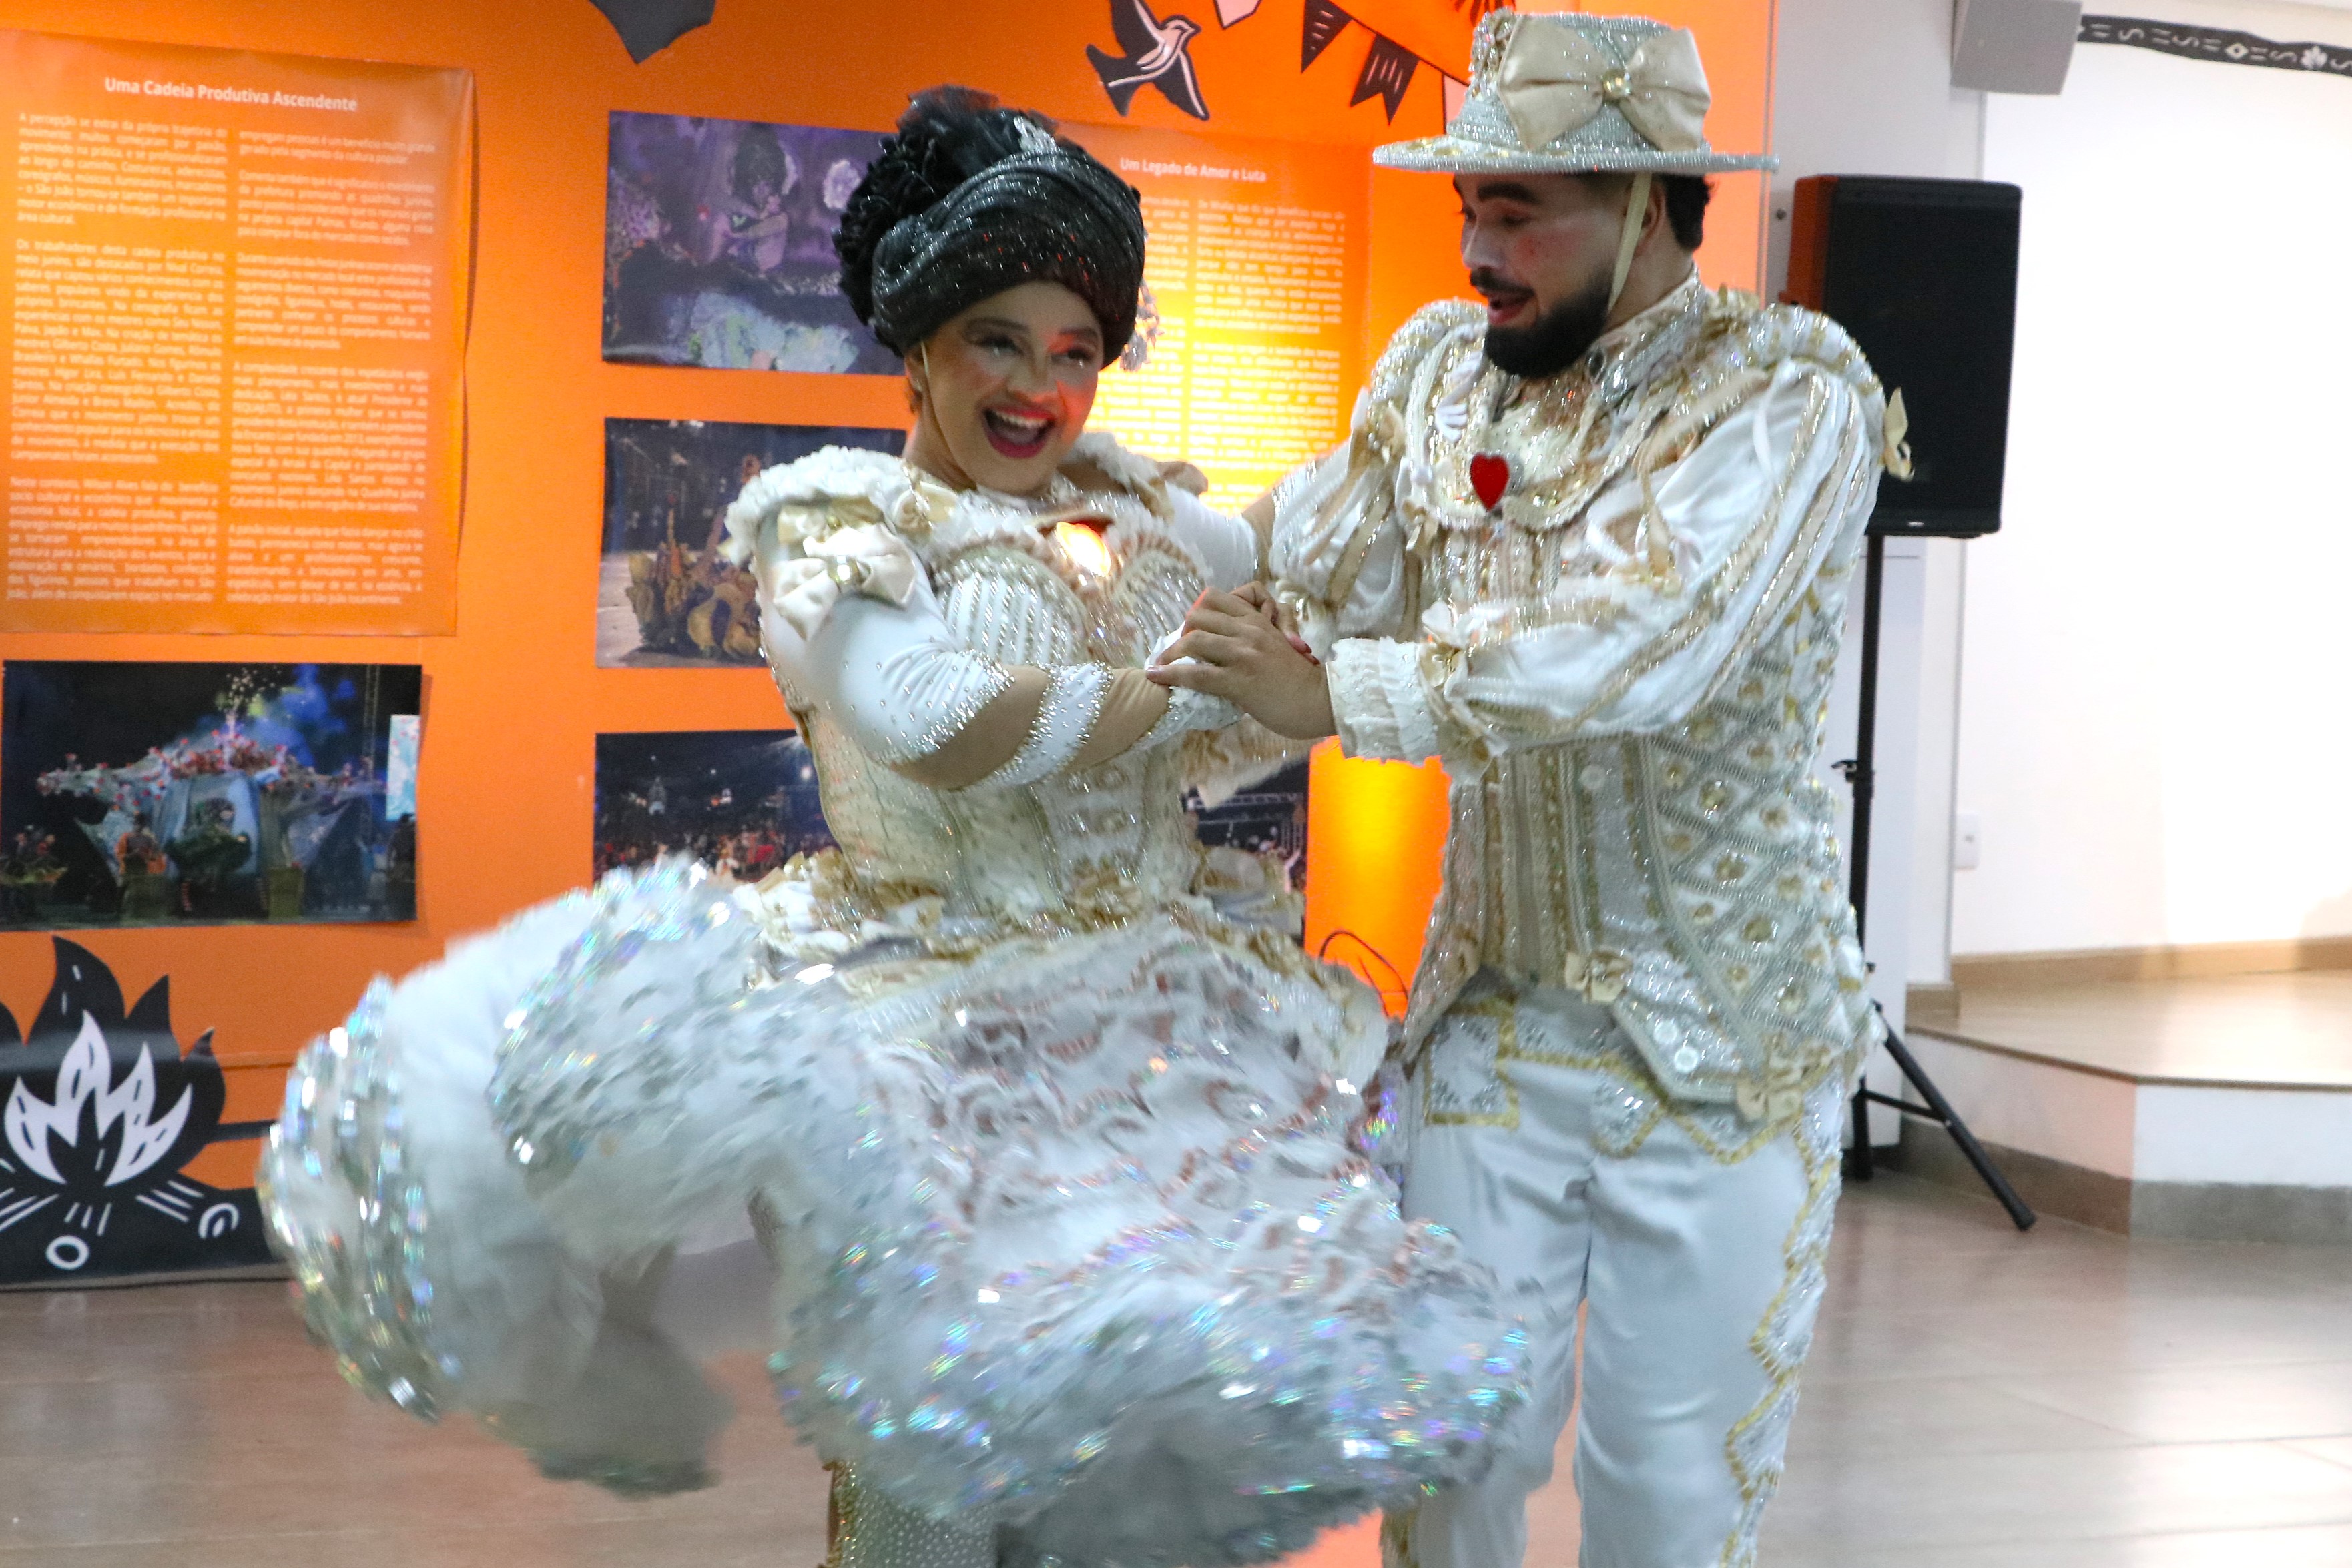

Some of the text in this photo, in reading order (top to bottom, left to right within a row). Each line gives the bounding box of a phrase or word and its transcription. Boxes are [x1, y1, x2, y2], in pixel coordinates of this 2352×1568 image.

[105, 77, 358, 111] Uma Cadeia Produtiva Ascendente
[1121, 157, 1267, 182] Um Legado de Amor e Luta
